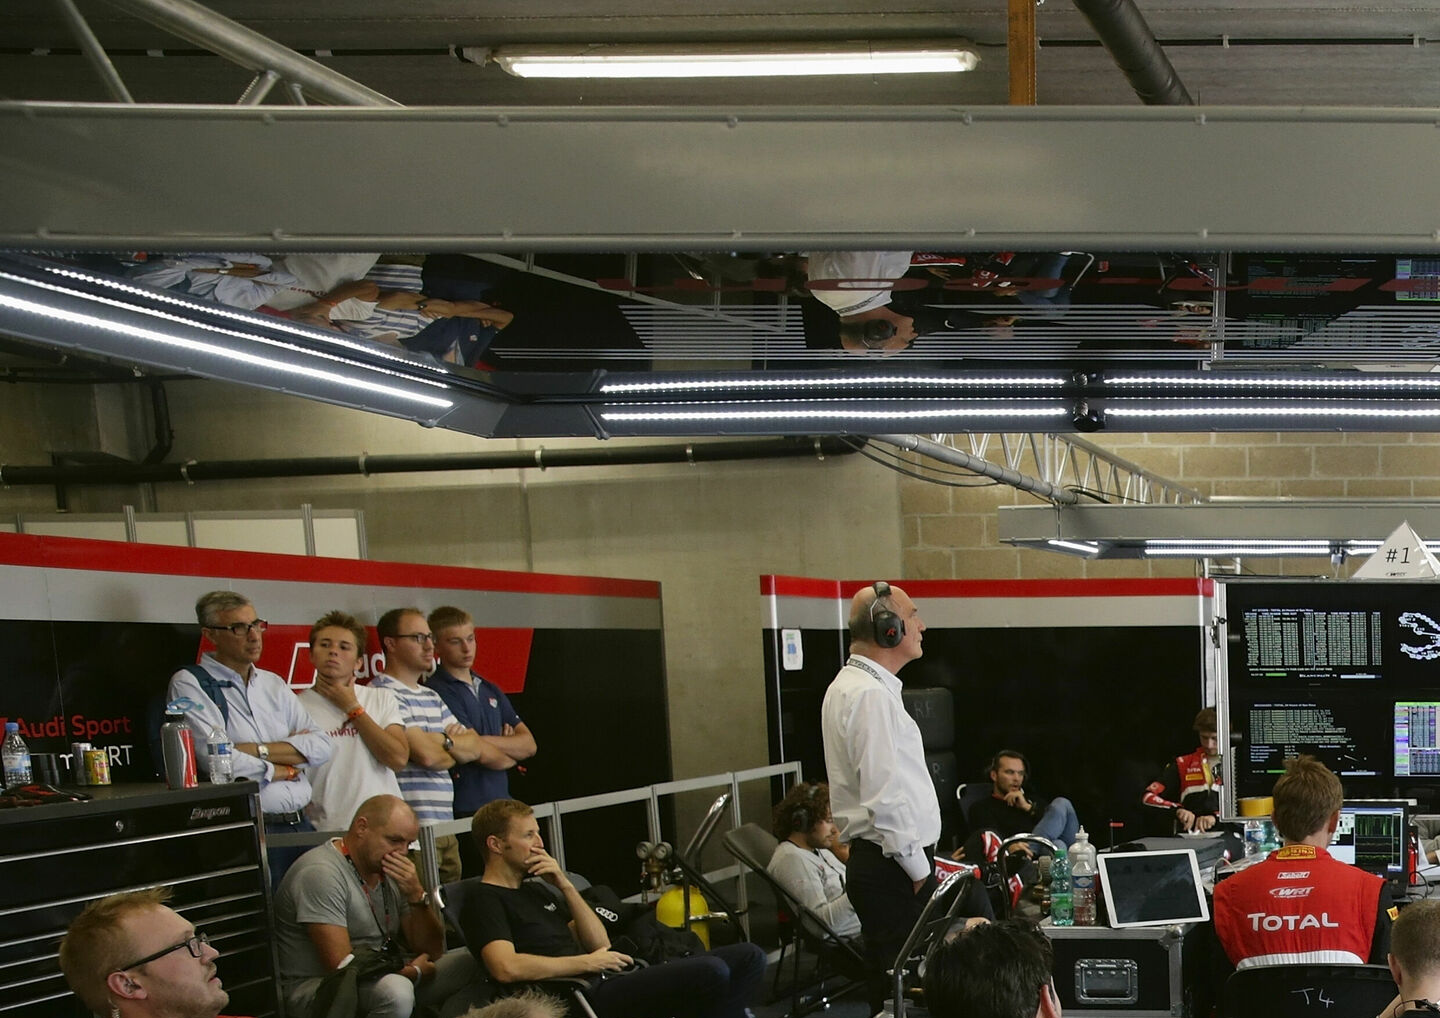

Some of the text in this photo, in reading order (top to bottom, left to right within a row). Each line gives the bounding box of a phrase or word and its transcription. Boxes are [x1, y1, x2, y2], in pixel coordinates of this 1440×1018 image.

[1386, 547, 1410, 564] #1
[17, 714, 131, 739] Audi Sport
[1247, 911, 1340, 932] TOTAL
